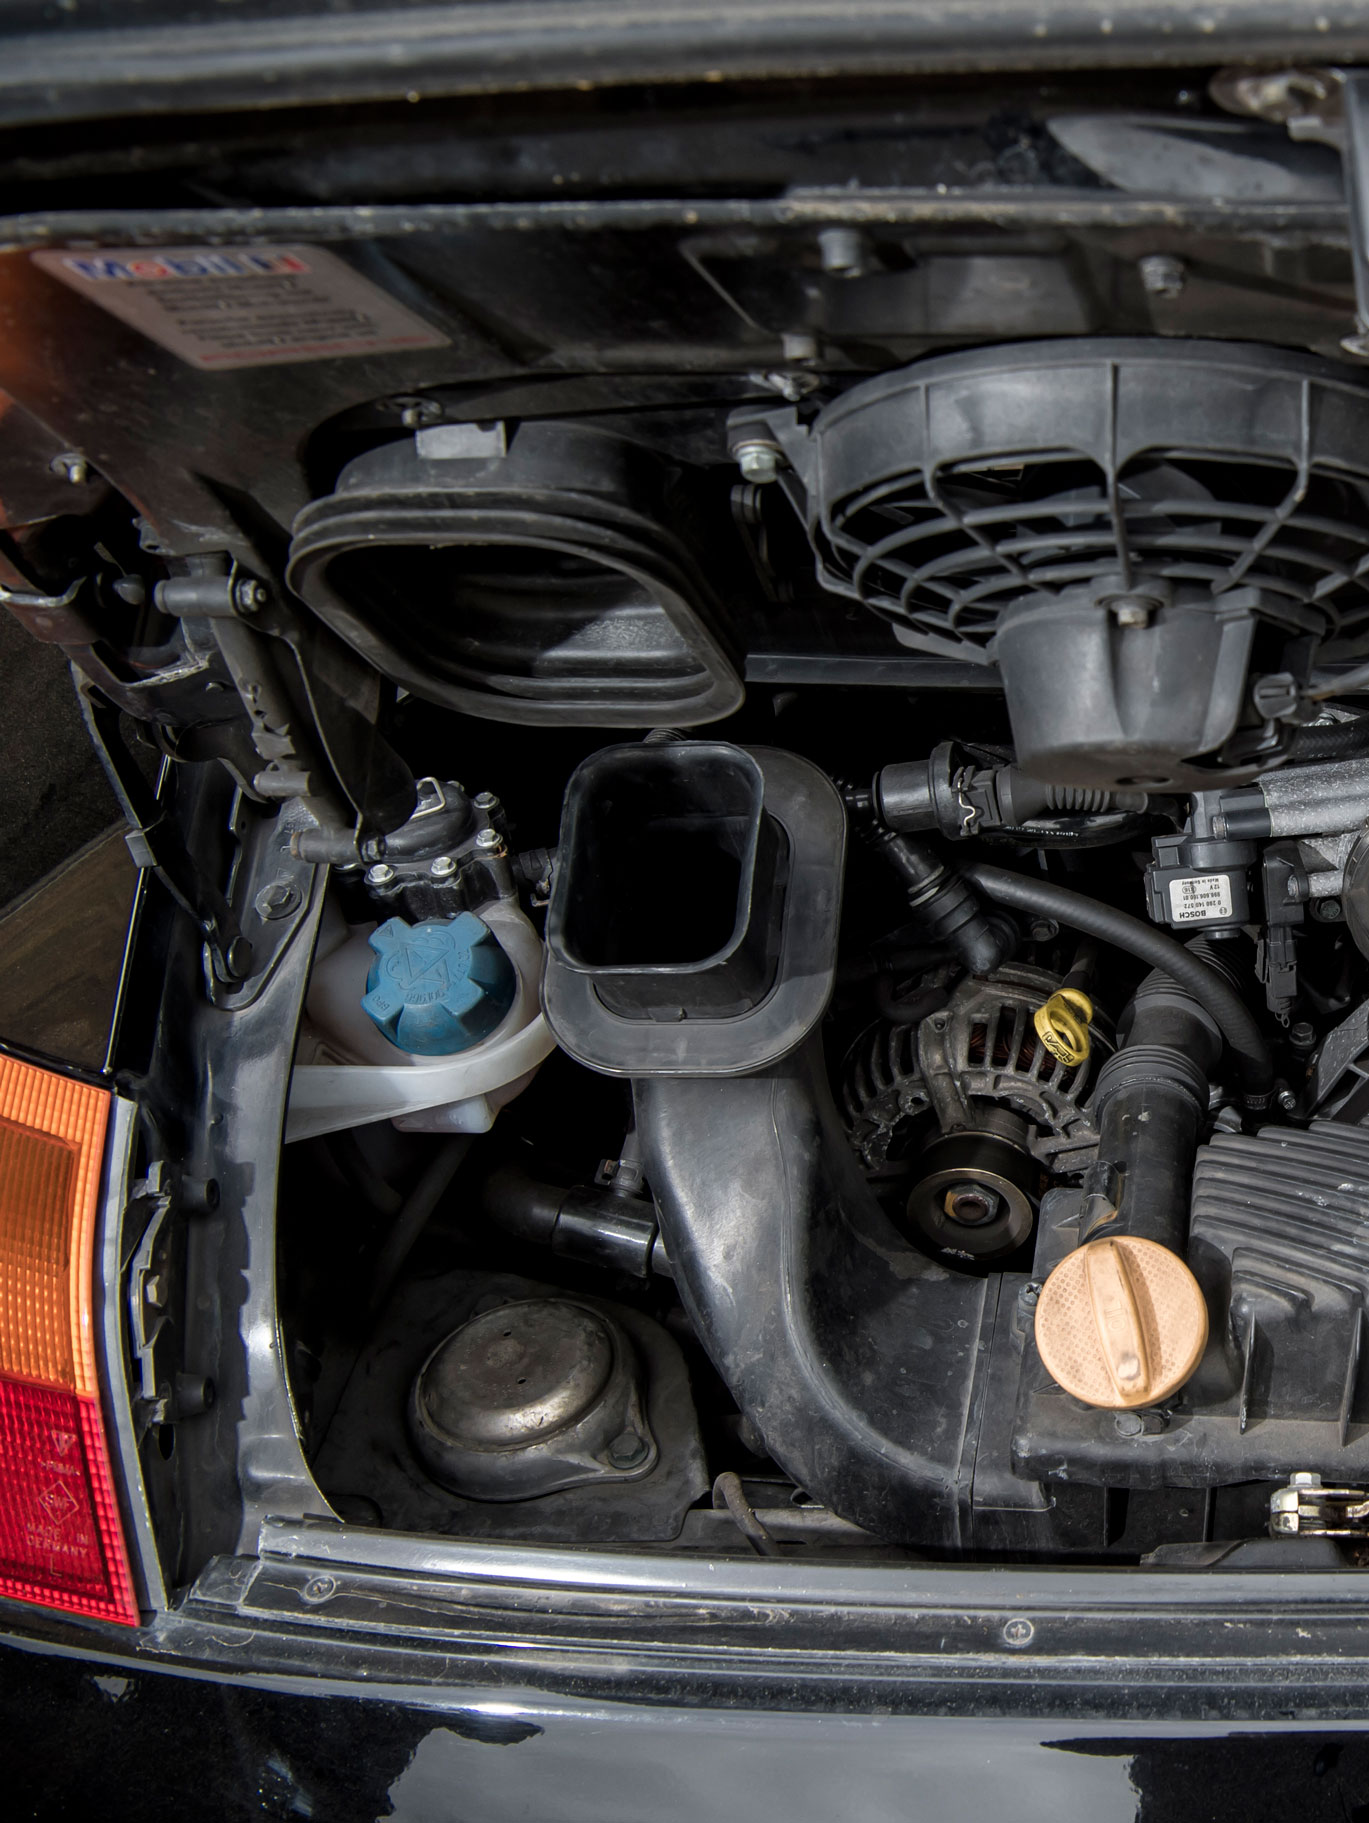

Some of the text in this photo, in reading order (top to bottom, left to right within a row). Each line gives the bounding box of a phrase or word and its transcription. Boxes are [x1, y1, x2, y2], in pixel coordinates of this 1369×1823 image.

[62, 254, 247, 280] Mobil
[1179, 910, 1206, 919] BOSCH
[28, 1523, 88, 1545] MADE IN
[28, 1535, 88, 1558] GERMANY
